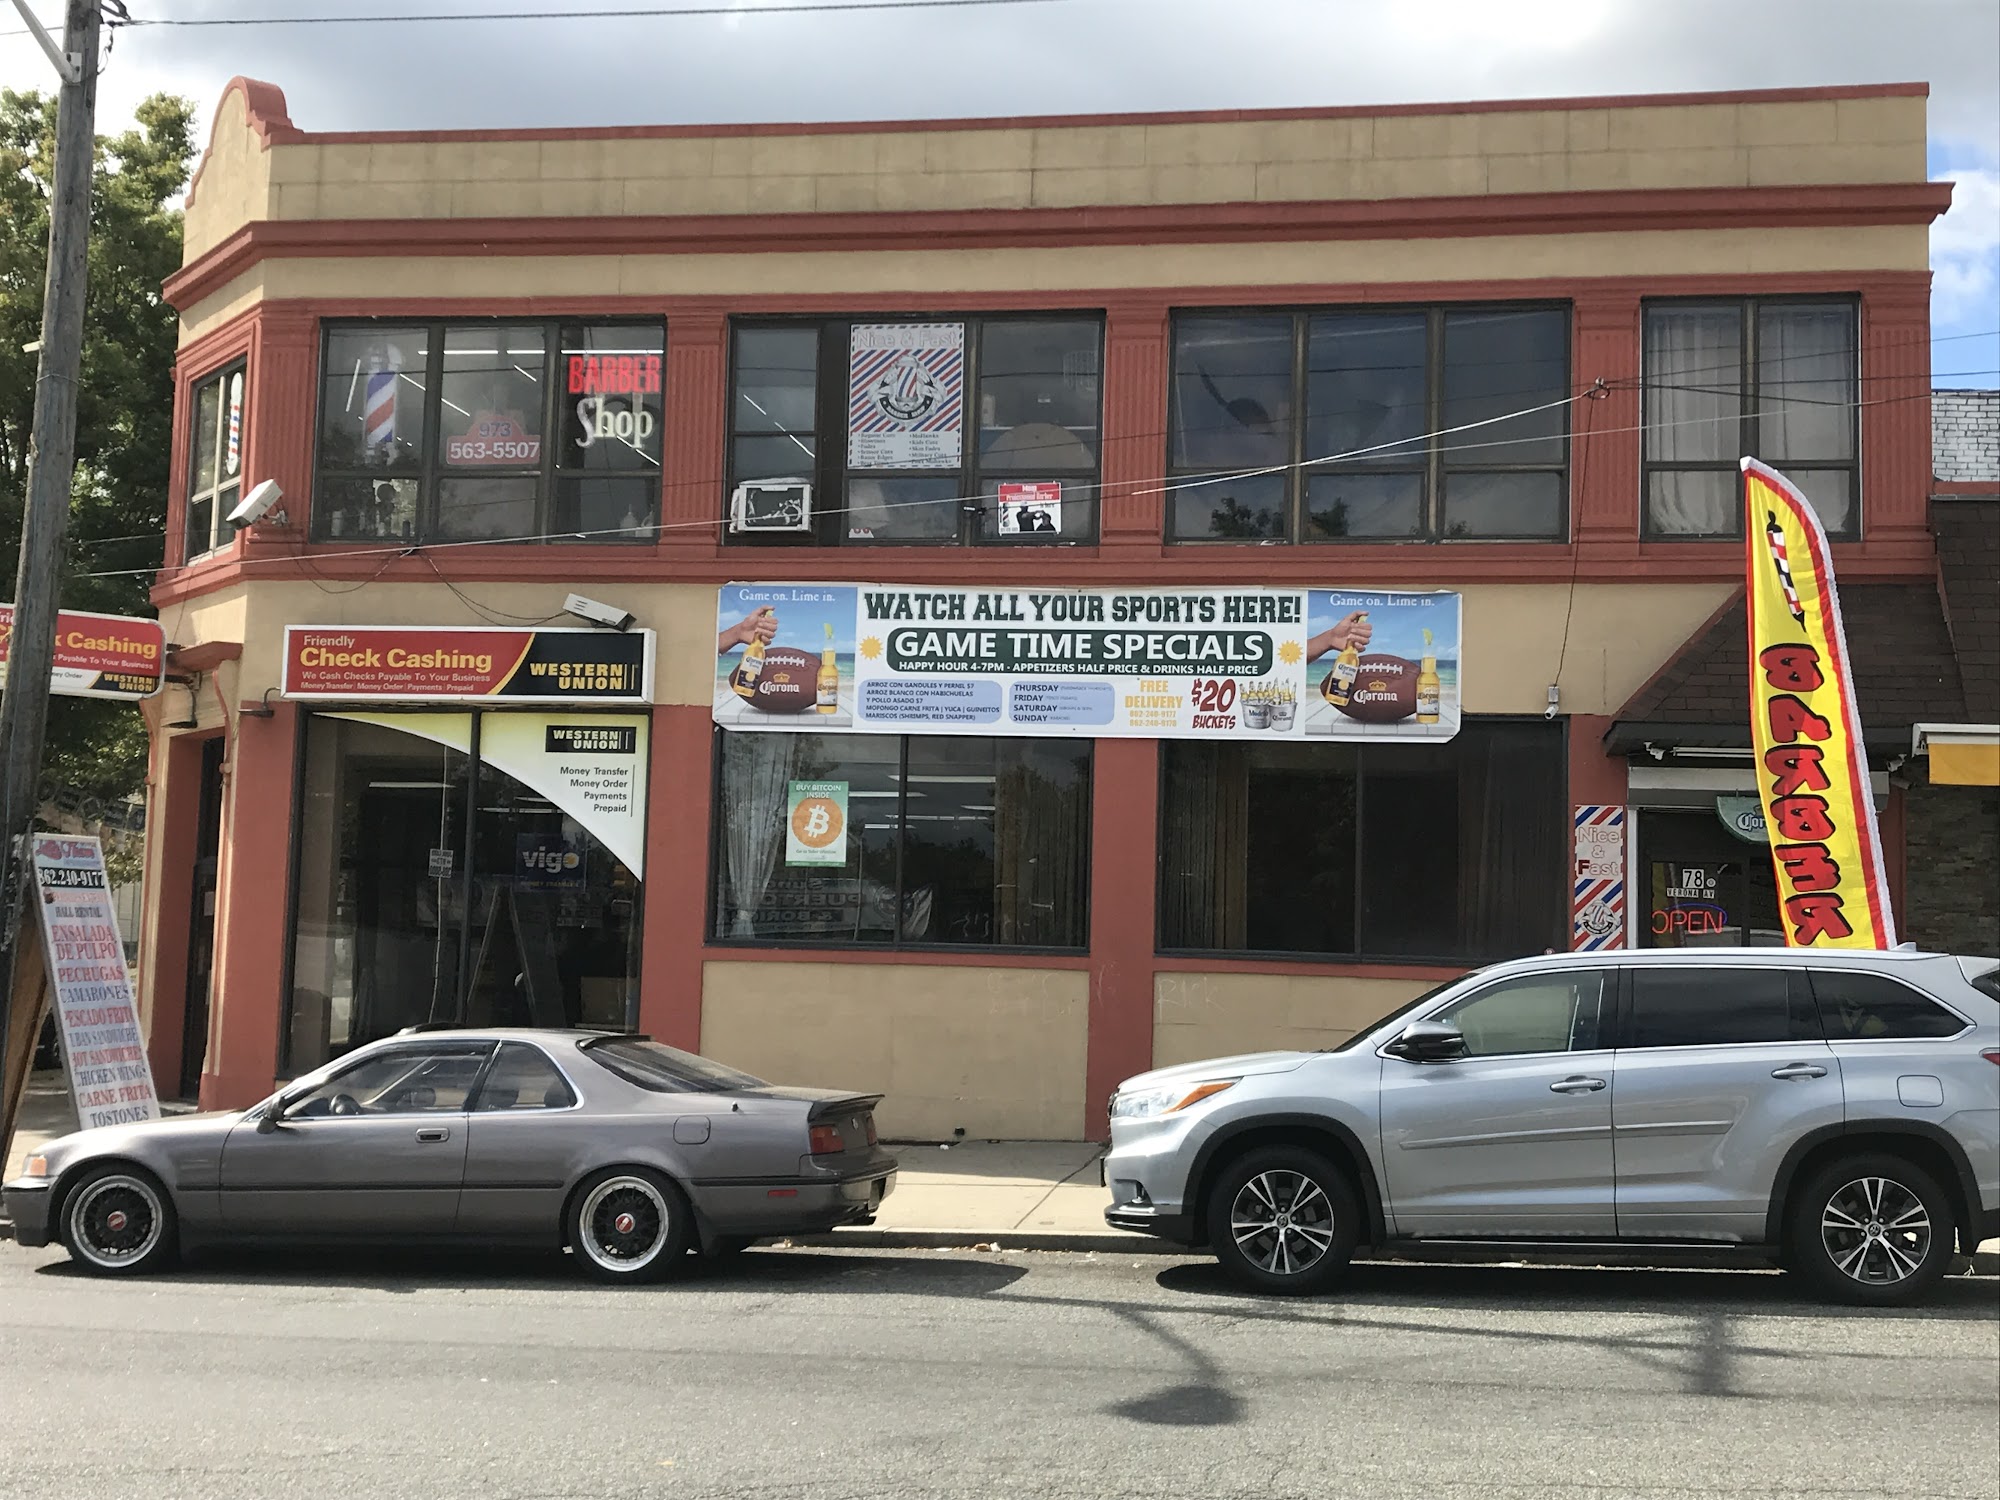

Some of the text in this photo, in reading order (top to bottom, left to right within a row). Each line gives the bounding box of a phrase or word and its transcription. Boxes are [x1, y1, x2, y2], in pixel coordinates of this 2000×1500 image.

[857, 331, 957, 348] Nice & Fast
[569, 356, 661, 394] BARBER
[574, 394, 653, 448] Shop
[479, 422, 511, 437] 973
[450, 442, 540, 459] 563-5507
[739, 588, 836, 601] Game on. Lime in.
[1329, 593, 1435, 607] Game on. Lime in.
[864, 593, 1301, 624] WATCH ALL YOUR SPORTS HERE!
[67, 631, 157, 660] Cashing
[303, 635, 356, 649] Friendly
[895, 631, 1264, 661] GAME TIME SPECIALS
[58, 653, 154, 670] Payable To Your Business
[300, 648, 492, 673] Check Cashing
[530, 663, 623, 677] WESTERN
[899, 661, 1258, 675] HAPPY HOUR 4-7PM APPETIZERS HALF PRICE & DRINKS HALF PRICE
[64, 671, 83, 680] Order
[104, 673, 152, 685] WESTERN
[302, 671, 491, 683] We Cash Checks Payable To Your Business
[118, 681, 152, 692] UNION
[301, 682, 474, 693] Money Transfer Money Order Payments Prepaid
[558, 677, 623, 690] UNION
[759, 680, 800, 695] Corona
[1015, 684, 1059, 692] THURSDAY
[1140, 680, 1169, 693] FREE
[1014, 694, 1044, 702] FRIDAY
[1125, 695, 1183, 709] DELIVERY
[1192, 678, 1236, 712] $20
[1353, 689, 1399, 704] Corona
[1013, 704, 1058, 712] SATURDAY
[1013, 714, 1048, 722] SUNDAY
[1192, 715, 1236, 729] BUCKETS
[553, 730, 619, 740] WESTERN
[573, 740, 618, 750] UNION
[560, 766, 628, 777] Money Transfer
[570, 779, 628, 789] Money Order
[584, 791, 627, 801] Payments
[806, 791, 830, 799] INSIDE
[593, 803, 627, 814] Prepaid
[1737, 813, 1766, 833] Cor
[1578, 826, 1620, 844] Nice
[1591, 845, 1606, 858] &
[522, 846, 579, 873] vigo
[1578, 859, 1620, 876] Fast
[1683, 870, 1704, 887] 78
[1667, 888, 1699, 897] VERONA
[1652, 911, 1723, 934] OPEN
[51, 924, 117, 943] ENSALADA
[56, 942, 118, 961] DE PULPO
[57, 966, 125, 983] PECHUGAS
[59, 984, 129, 1004] CAMARONES
[91, 1027, 139, 1045] SANDWICHE
[78, 1084, 152, 1108] CARNE FRITA
[90, 1105, 149, 1128] TOSTONES
